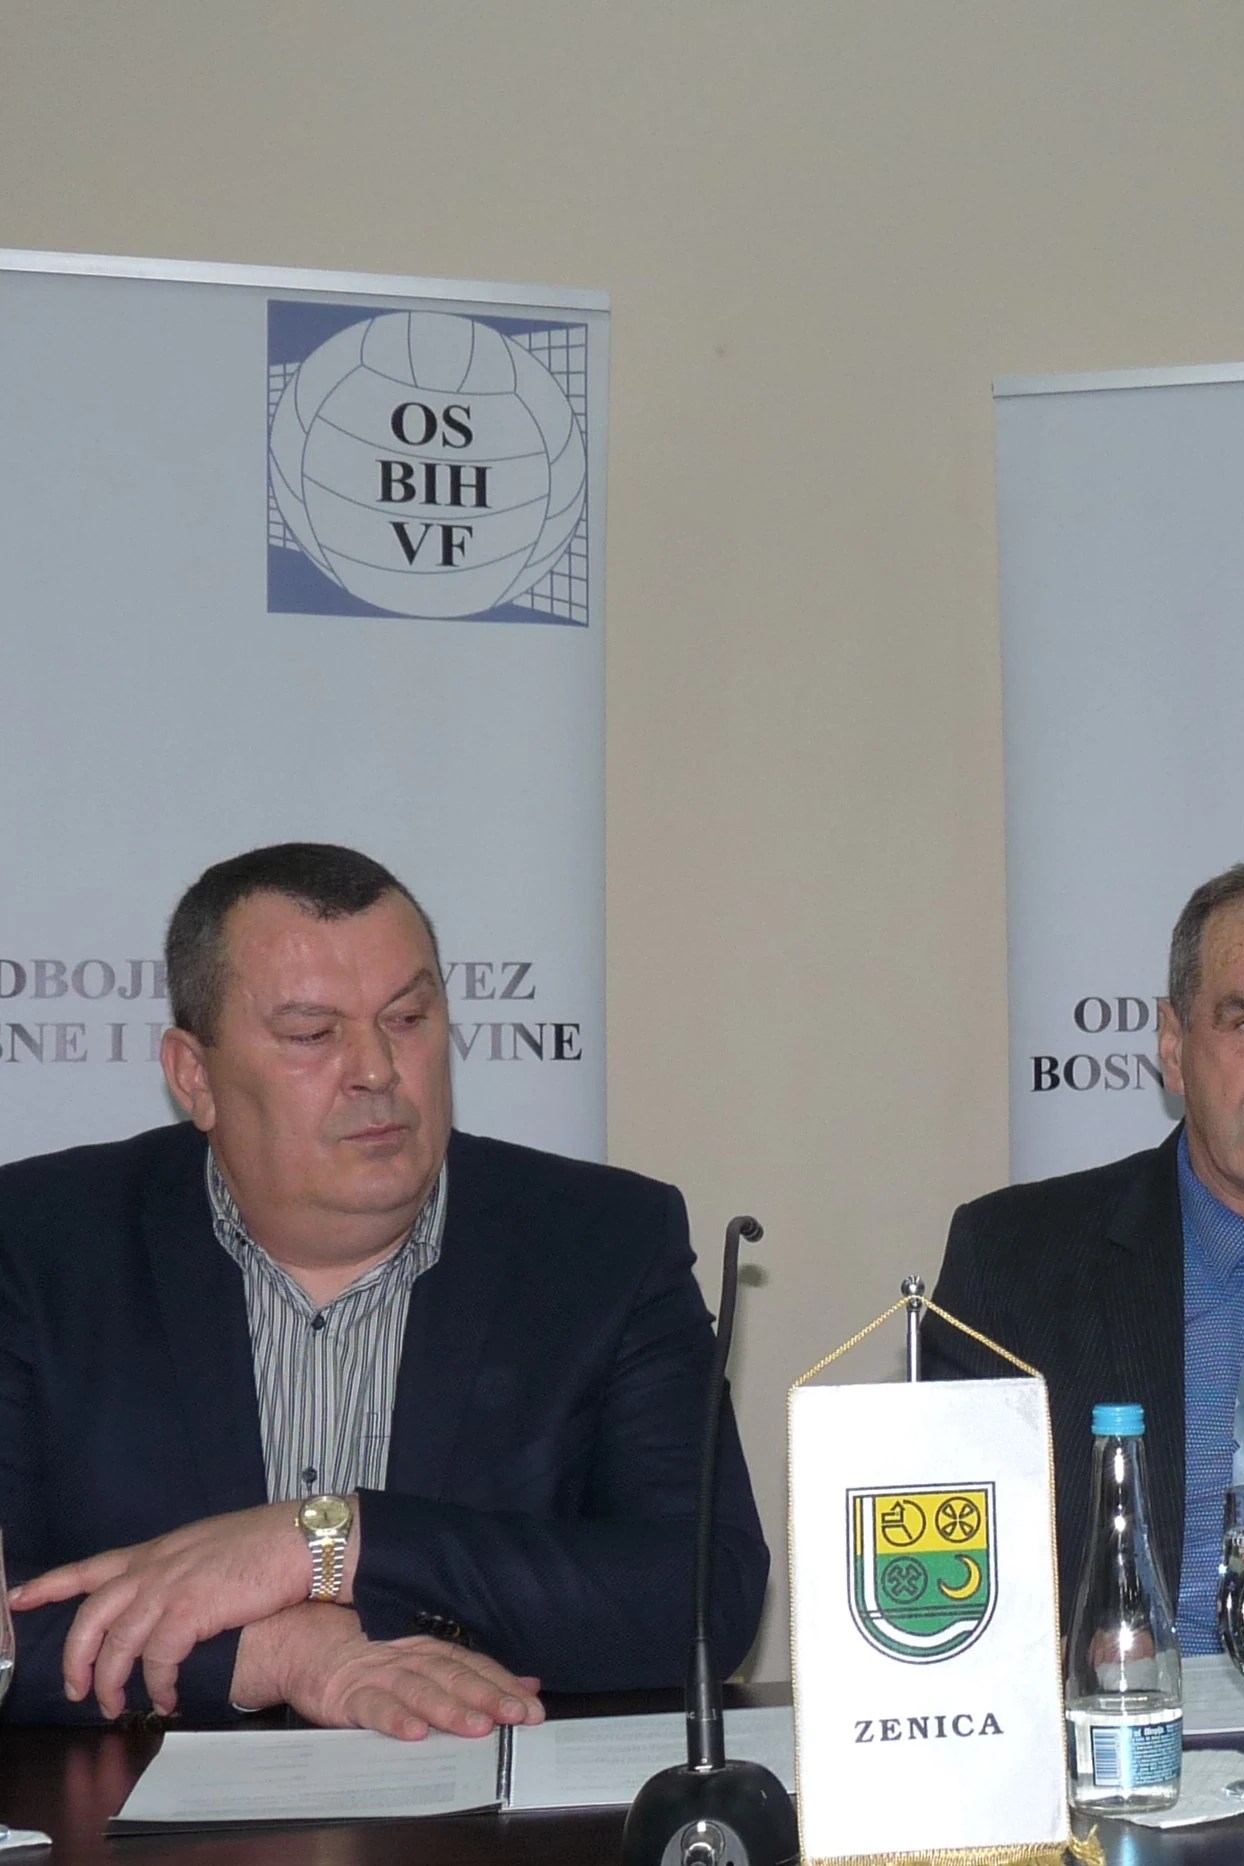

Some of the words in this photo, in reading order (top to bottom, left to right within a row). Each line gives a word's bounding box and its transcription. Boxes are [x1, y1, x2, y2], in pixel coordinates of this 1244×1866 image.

[391, 402, 474, 449] OS
[375, 459, 492, 508] BIH
[388, 520, 473, 567] VF
[0, 1022, 88, 1064] NE
[105, 1022, 128, 1063] I
[854, 1712, 1005, 1744] ZENICA
